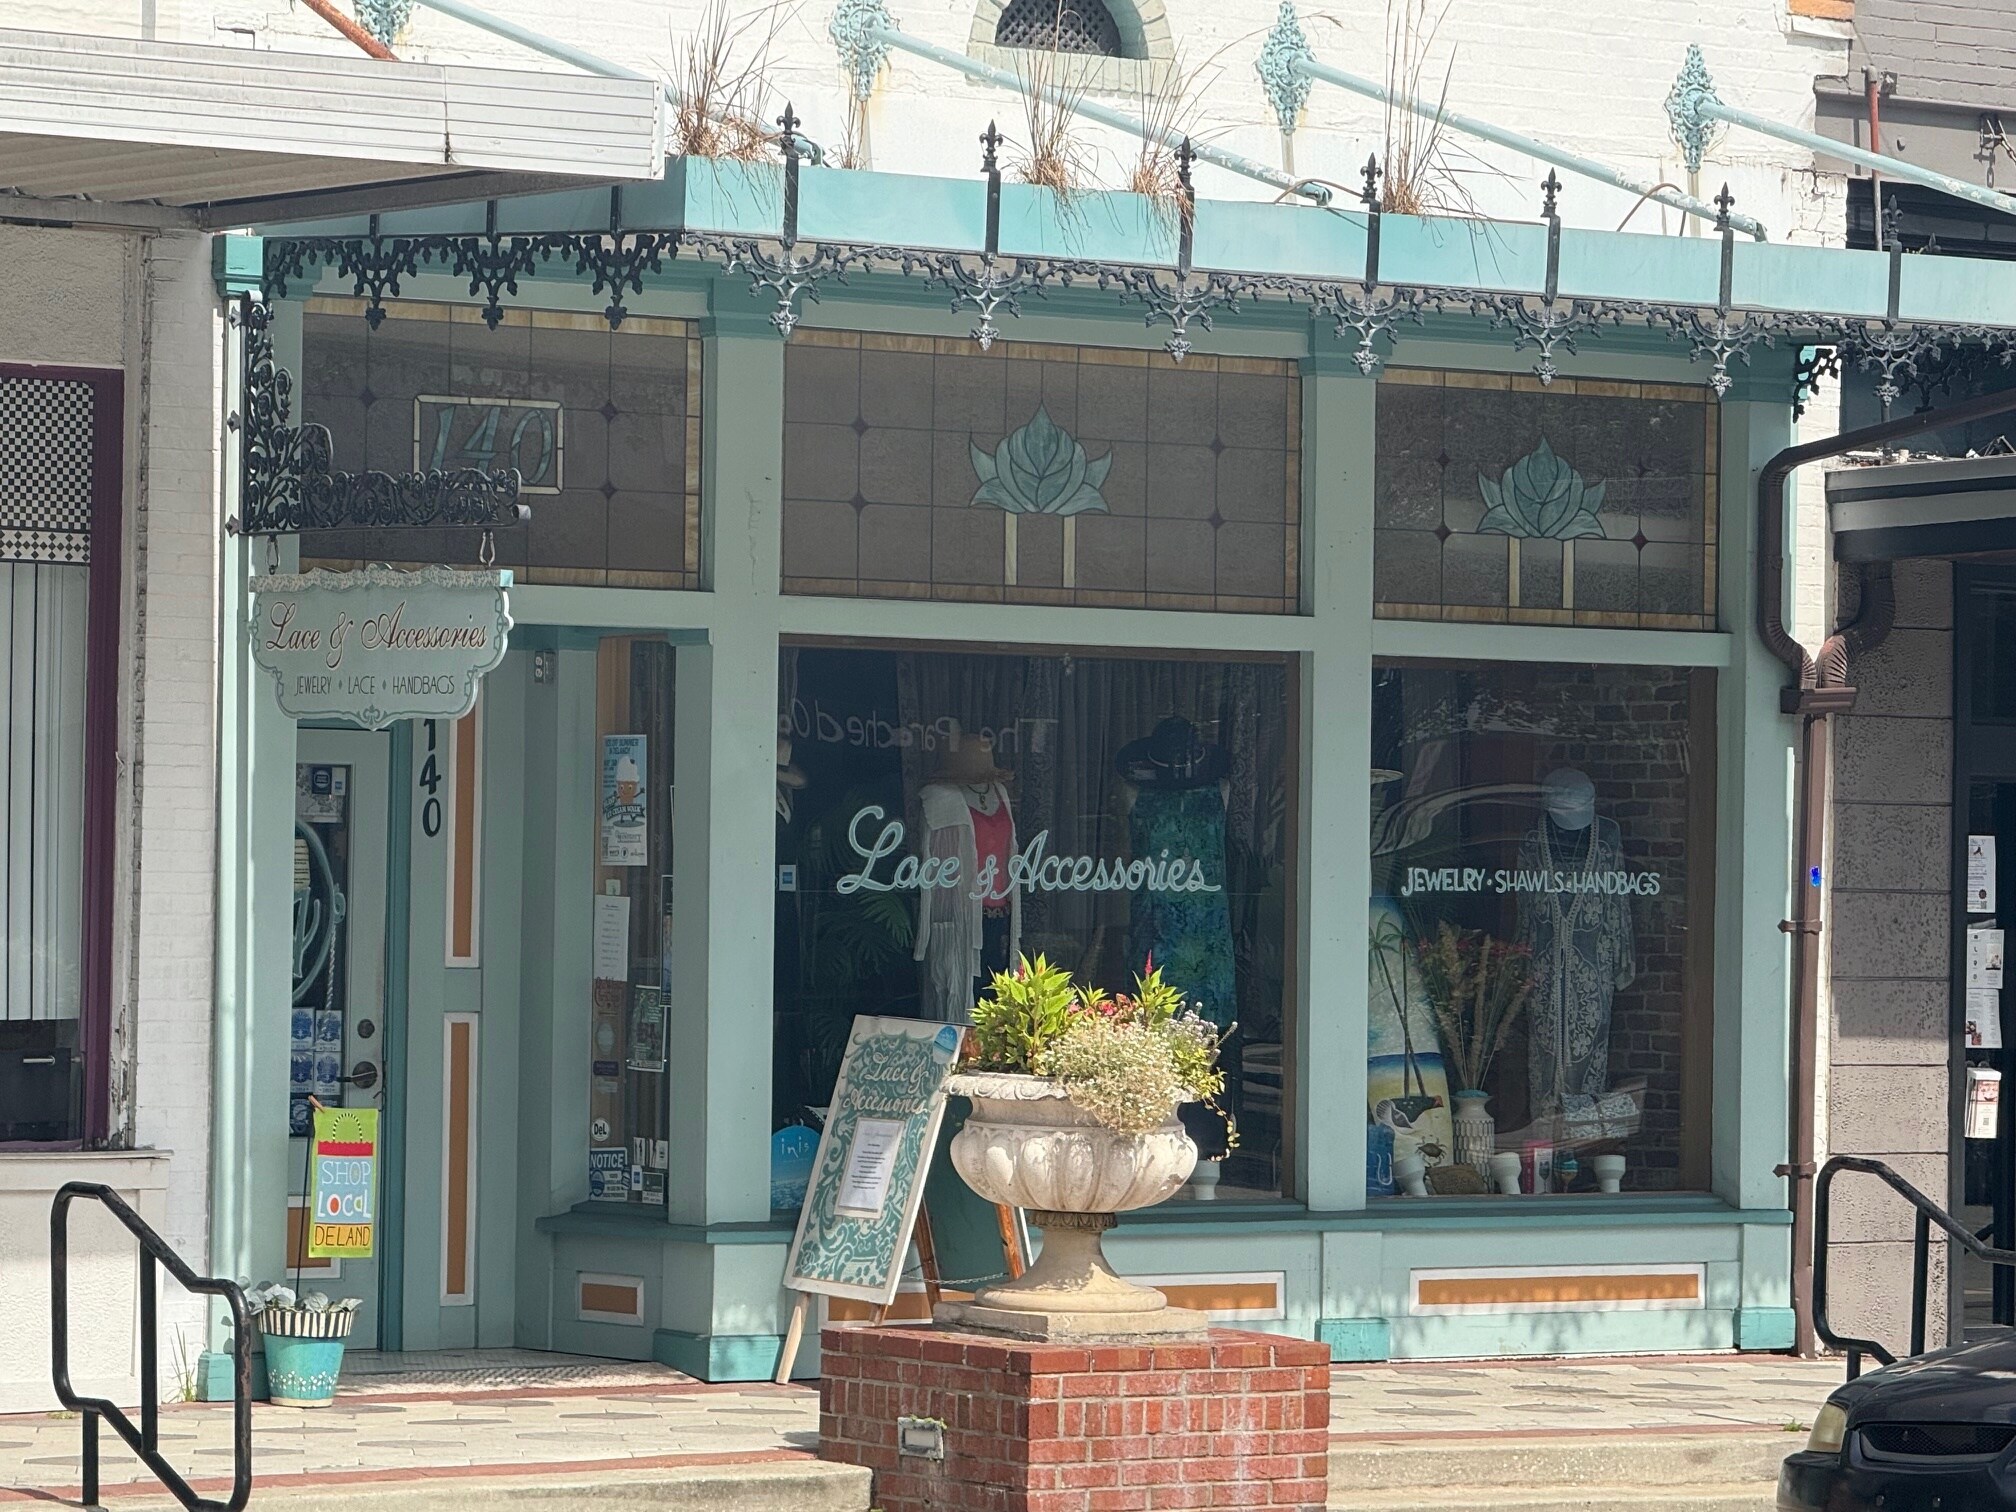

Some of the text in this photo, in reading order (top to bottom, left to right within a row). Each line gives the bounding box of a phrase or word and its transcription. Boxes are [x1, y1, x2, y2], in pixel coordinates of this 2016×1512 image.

[430, 405, 553, 484] 140
[266, 601, 487, 669] Lace & Accessories
[294, 675, 455, 696] JEWELRY LACE HANDBAGS
[419, 718, 441, 838] 140
[837, 805, 1221, 899] Lace & Accessories
[1401, 867, 1661, 896] JEWELRY SHAWLS HANDBAGS
[864, 1052, 929, 1094] Lace &
[843, 1089, 932, 1115] Accessories
[593, 1123, 607, 1136] DeL
[781, 1135, 810, 1158] inis
[321, 1160, 371, 1185] SHOP
[590, 1153, 624, 1169] NOTICE
[314, 1225, 371, 1246] DELAND
